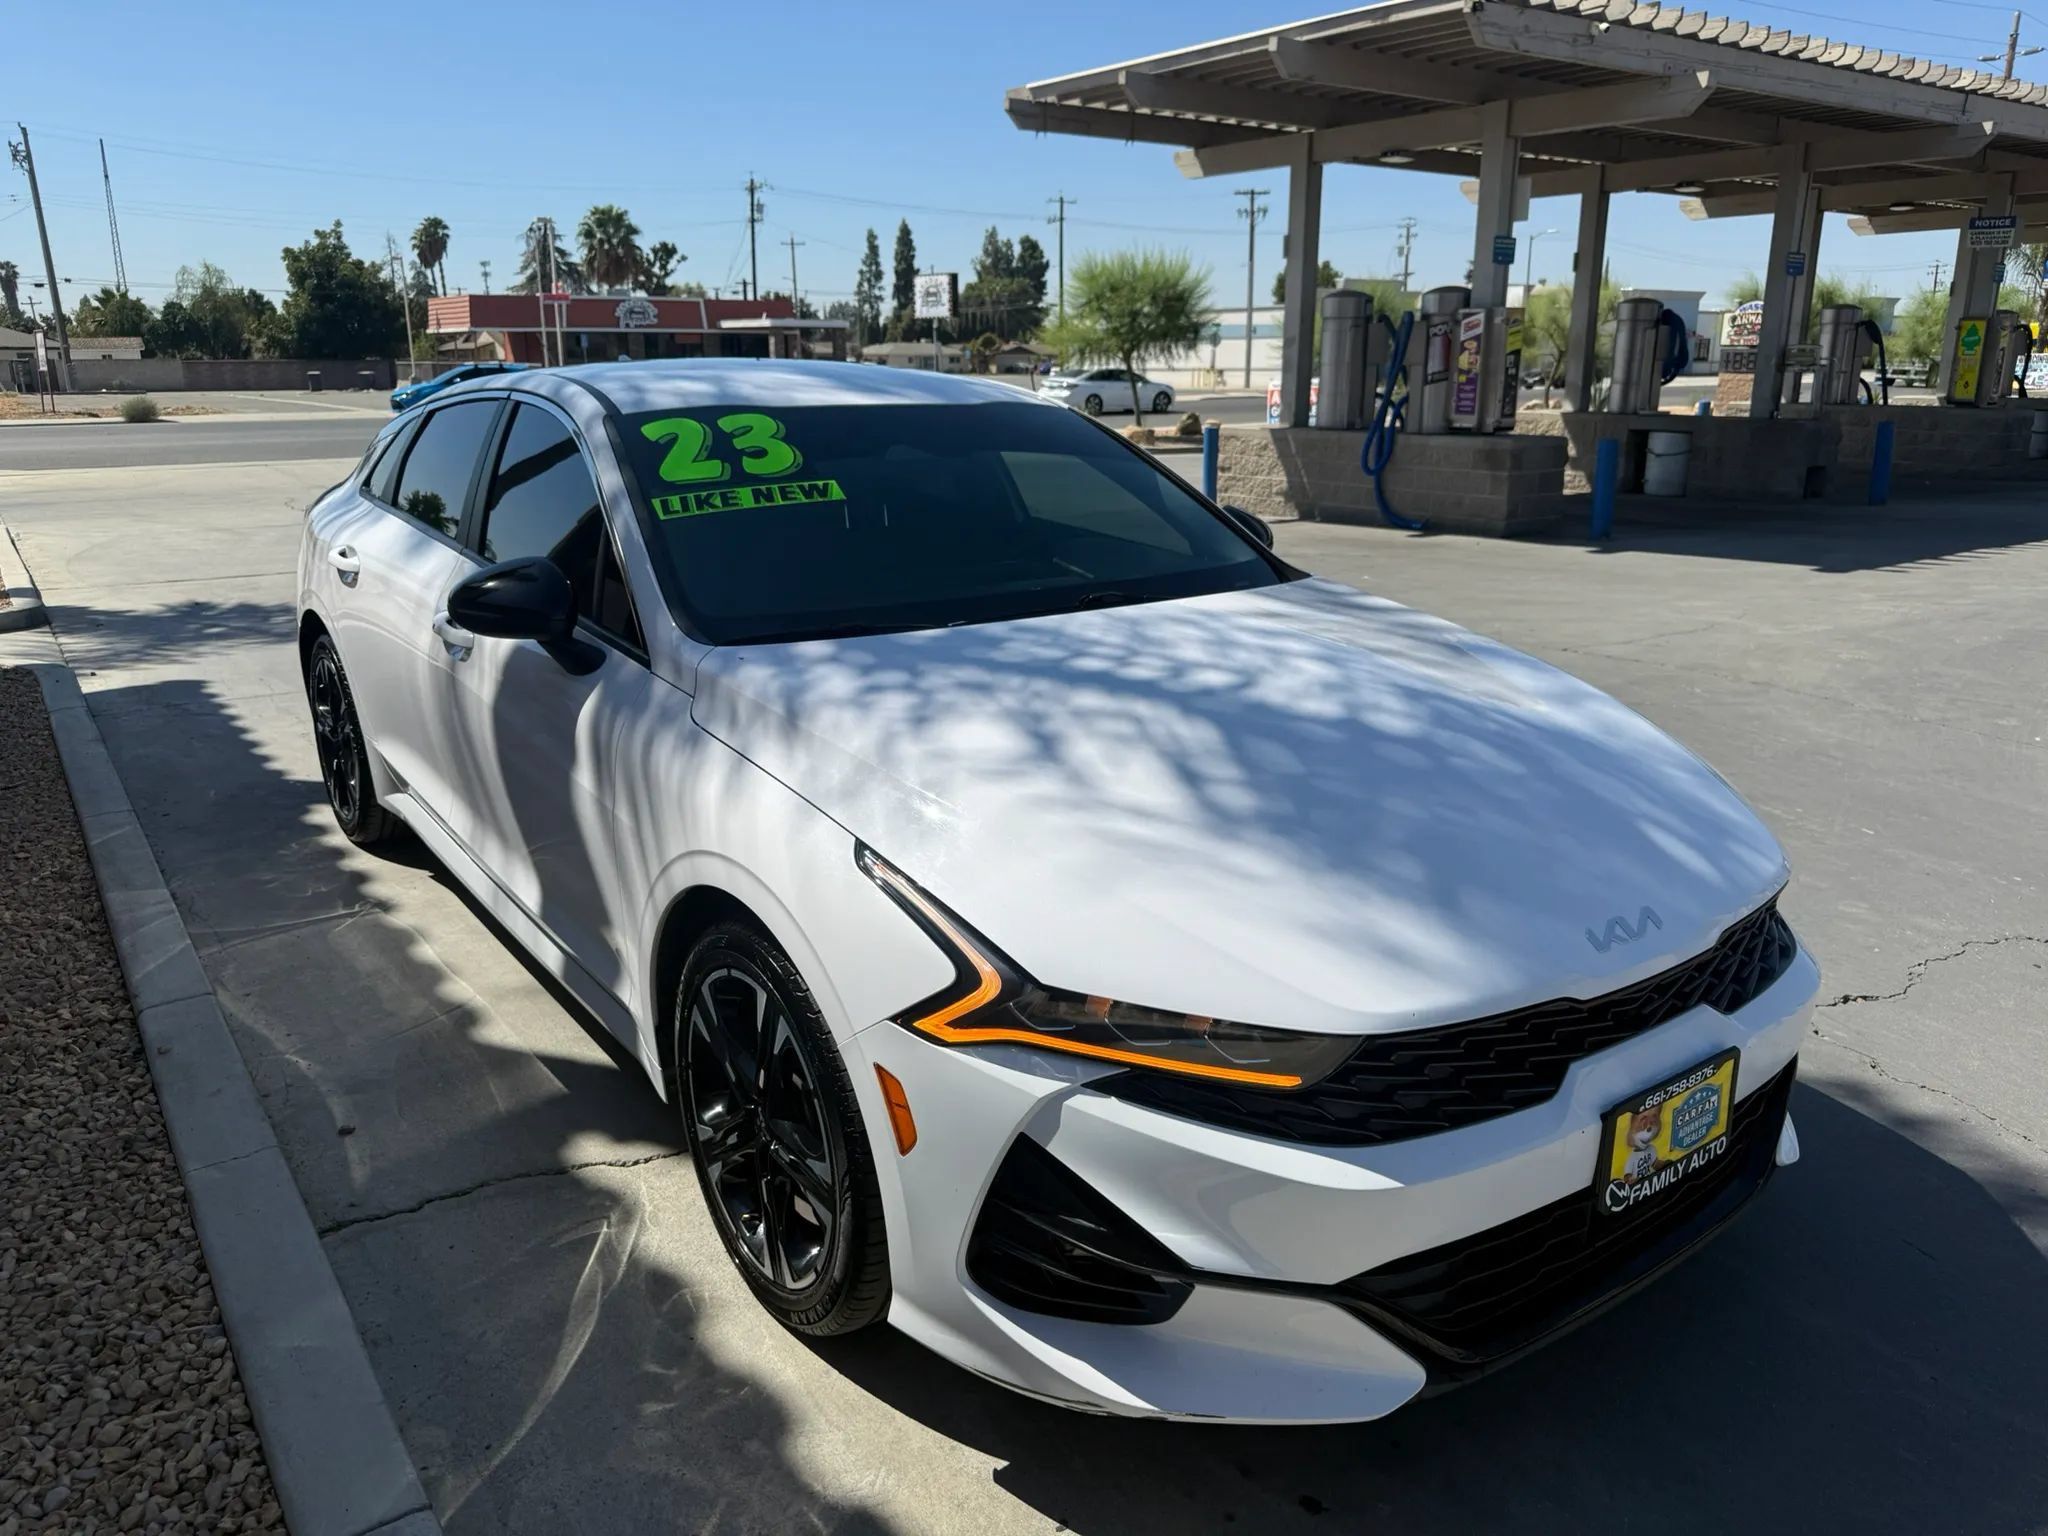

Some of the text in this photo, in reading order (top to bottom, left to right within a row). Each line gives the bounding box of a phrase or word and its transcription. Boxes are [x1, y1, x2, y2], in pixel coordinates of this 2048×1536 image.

[1975, 218, 2012, 227] NOTICE
[640, 413, 804, 484] 23
[658, 481, 832, 518] LIKE NEW
[1645, 1064, 1714, 1109] 661-758-8376
[1677, 1094, 1718, 1126] CARFAX
[1678, 1112, 1714, 1139] ADVANTAGE
[1683, 1126, 1708, 1148] DEALER
[1630, 1136, 1727, 1206] FAMILY AUTO
[1637, 1153, 1652, 1169] CAR
